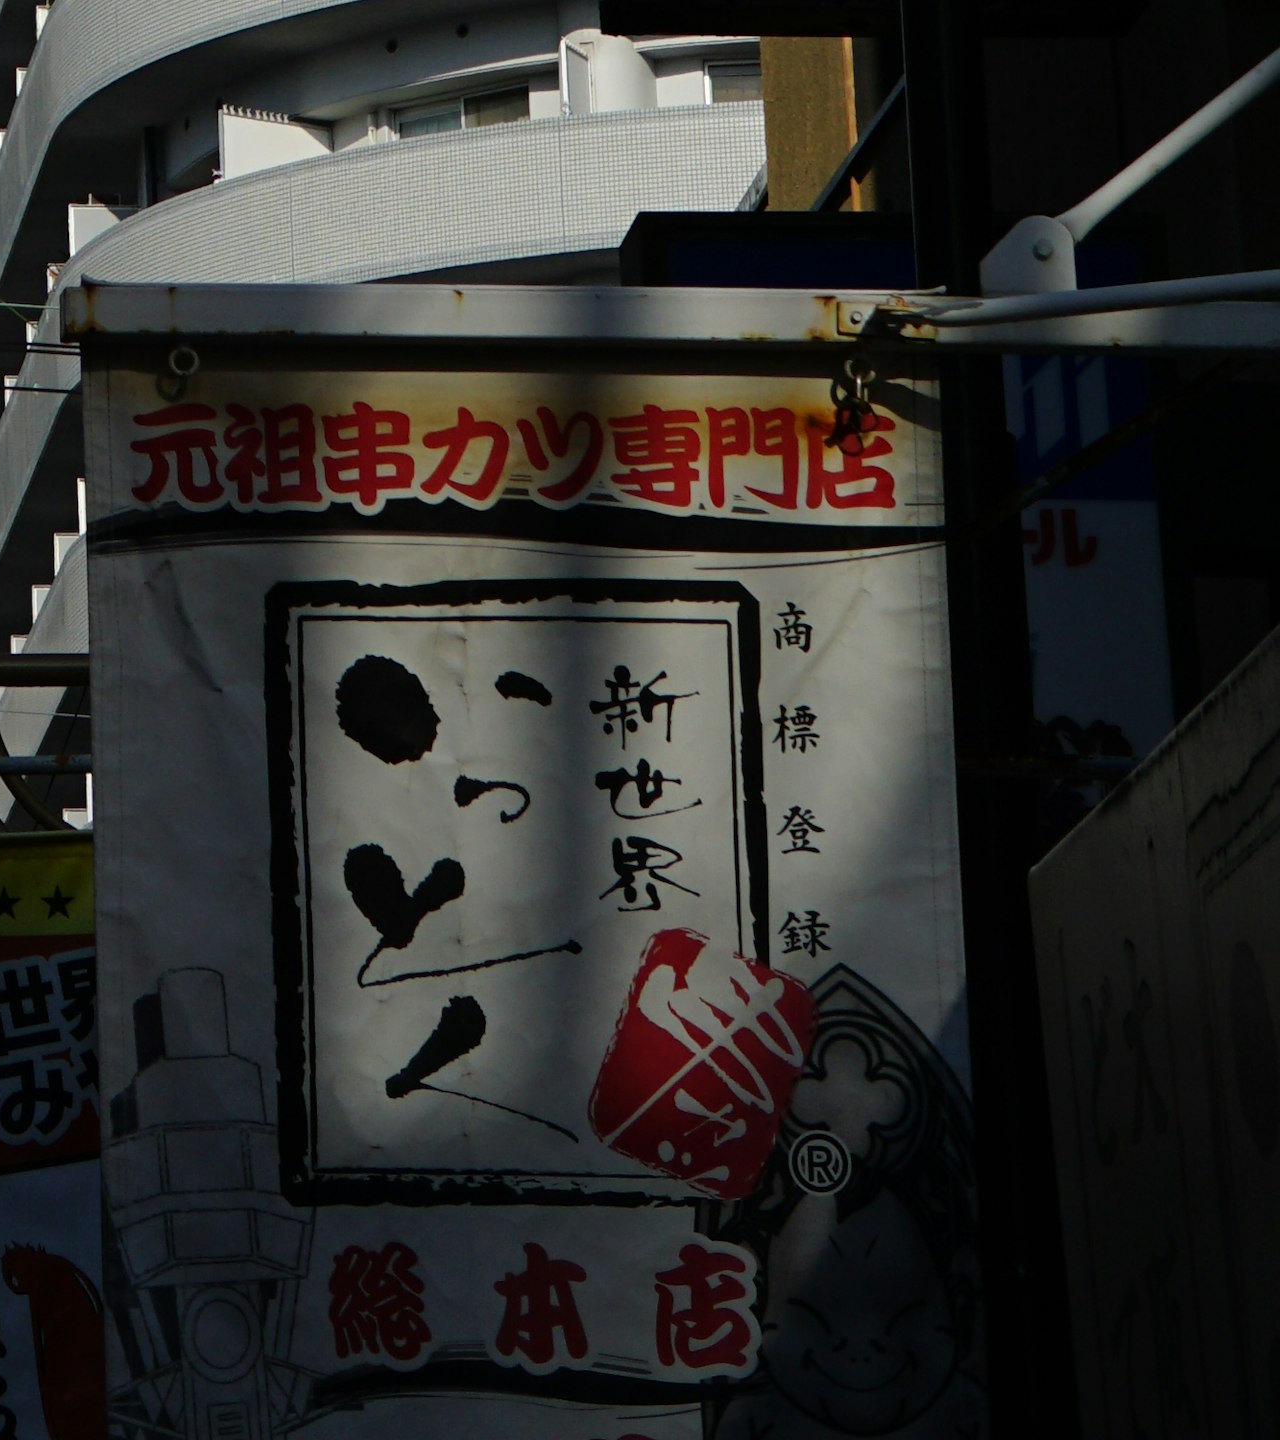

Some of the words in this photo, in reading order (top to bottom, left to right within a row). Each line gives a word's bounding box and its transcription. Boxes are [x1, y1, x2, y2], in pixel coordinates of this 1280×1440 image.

[130, 400, 900, 510] 元祖串カツ専門店
[589, 665, 703, 912] 新世界
[773, 601, 833, 958] 商標登録
[328, 1242, 753, 1370] 総本店
